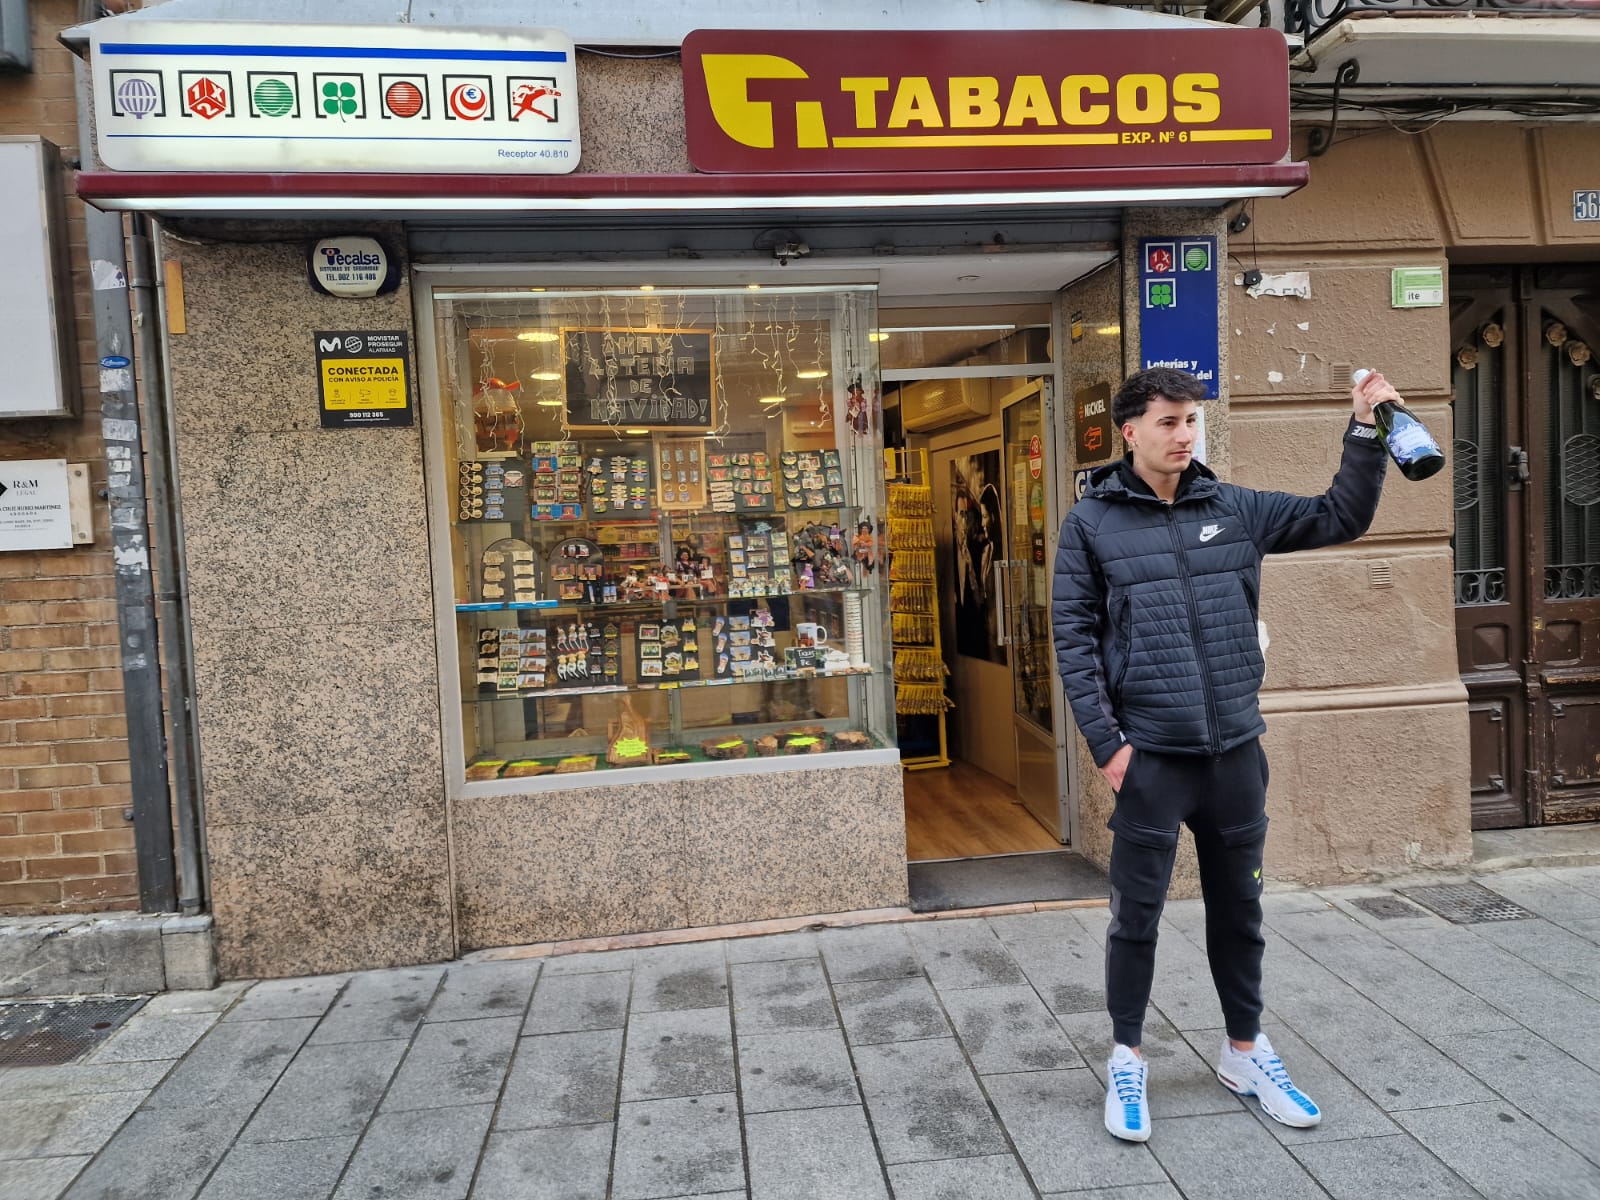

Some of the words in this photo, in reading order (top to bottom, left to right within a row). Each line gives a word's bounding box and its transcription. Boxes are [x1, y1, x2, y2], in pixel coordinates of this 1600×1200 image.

[840, 72, 1221, 129] TABACOS
[1121, 132, 1156, 144] EXP.
[1159, 131, 1175, 143] Nº
[1178, 131, 1188, 142] 6
[497, 149, 537, 159] Receptor
[539, 150, 569, 158] 40.810
[320, 247, 381, 266] Tecalsa
[1191, 360, 1198, 370] y
[327, 366, 399, 376] CONECTADA
[1196, 370, 1213, 380] del
[13, 479, 39, 489] R&M
